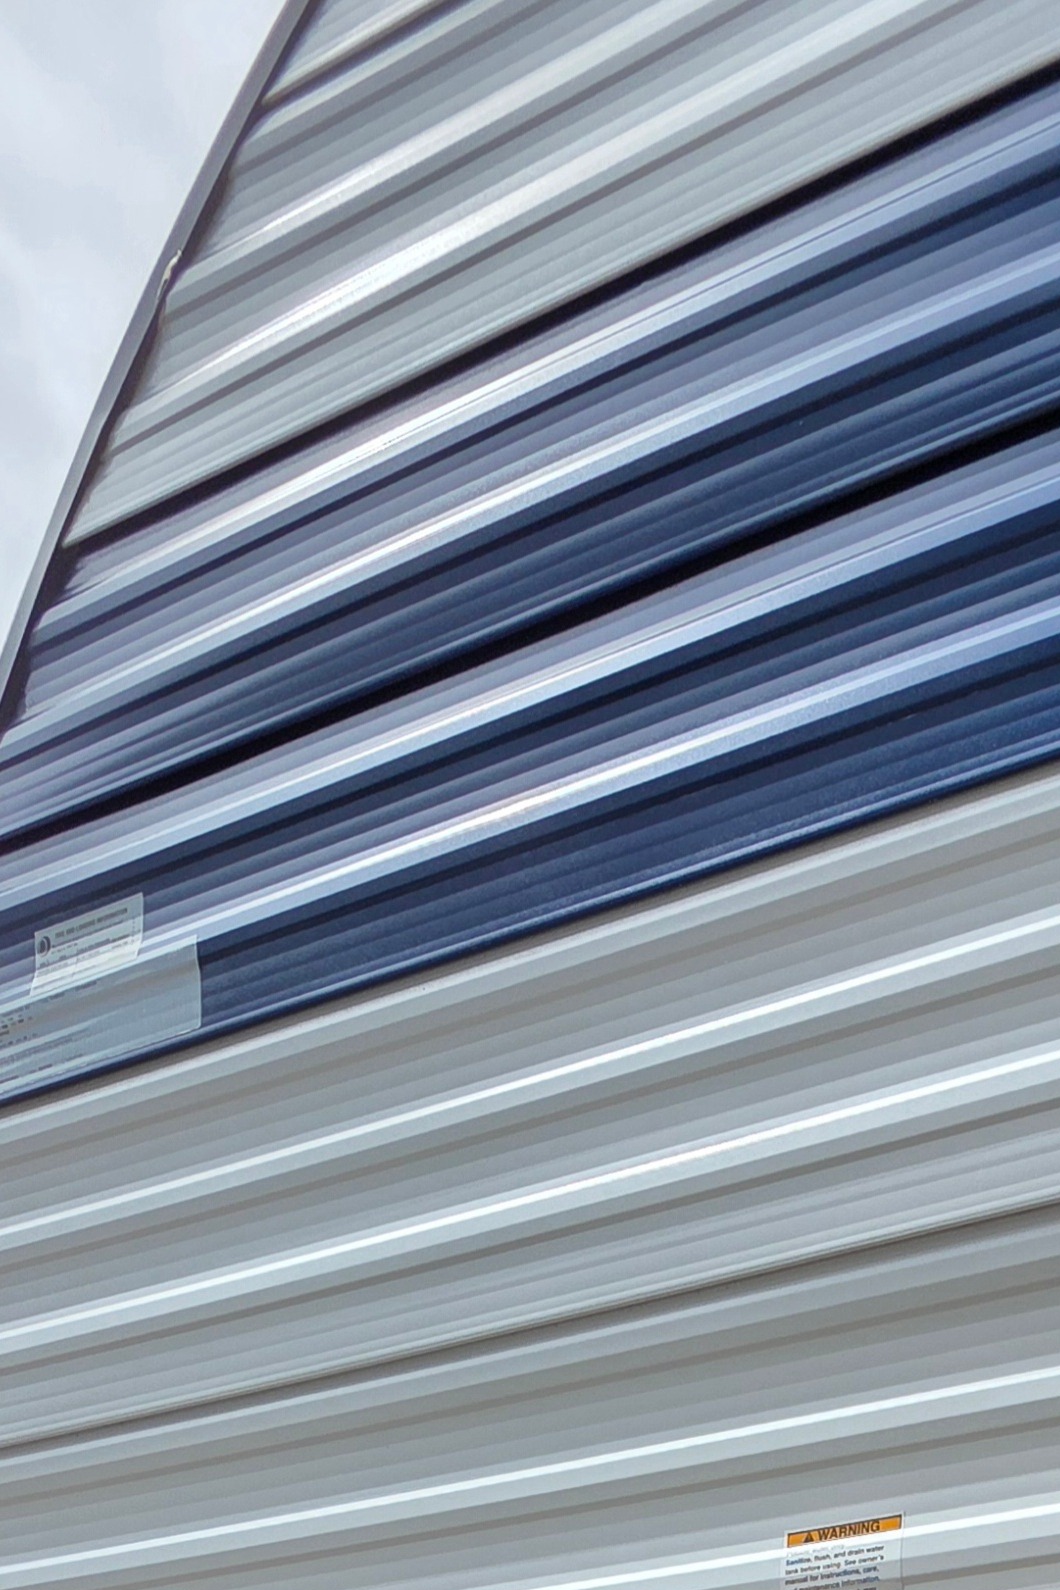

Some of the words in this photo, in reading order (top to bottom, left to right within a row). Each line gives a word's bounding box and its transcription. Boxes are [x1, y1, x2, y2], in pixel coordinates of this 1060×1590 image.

[817, 1521, 880, 1541] WARNING
[834, 1551, 846, 1559] and
[848, 1548, 864, 1556] drain
[866, 1545, 884, 1553] water
[785, 1568, 798, 1576] tank
[801, 1564, 820, 1573] before
